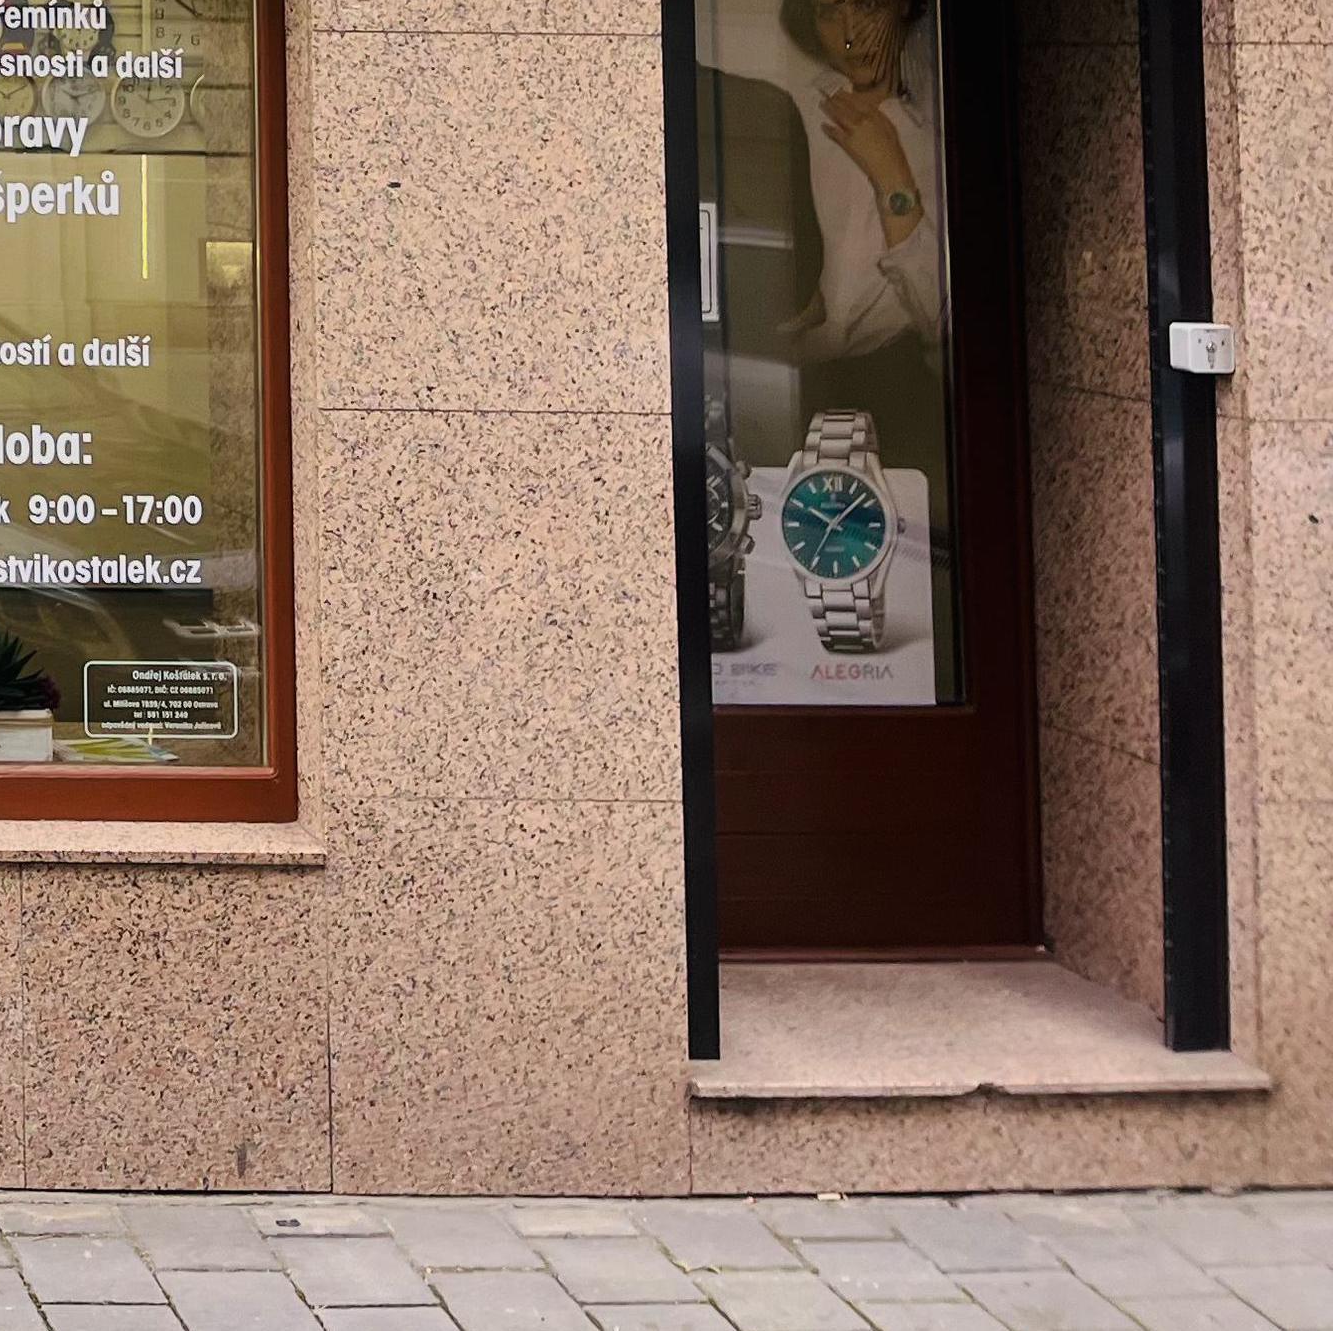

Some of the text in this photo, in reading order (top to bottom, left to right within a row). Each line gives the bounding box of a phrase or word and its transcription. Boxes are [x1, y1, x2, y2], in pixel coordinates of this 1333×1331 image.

[92, 56, 108, 79] a
[115, 48, 184, 80] další
[57, 343, 76, 367] a
[82, 335, 152, 367] další
[28, 494, 95, 526] 9:00
[121, 494, 204, 526] 17:00
[132, 670, 162, 682] Ondřej
[811, 664, 894, 680] ALEGRIA
